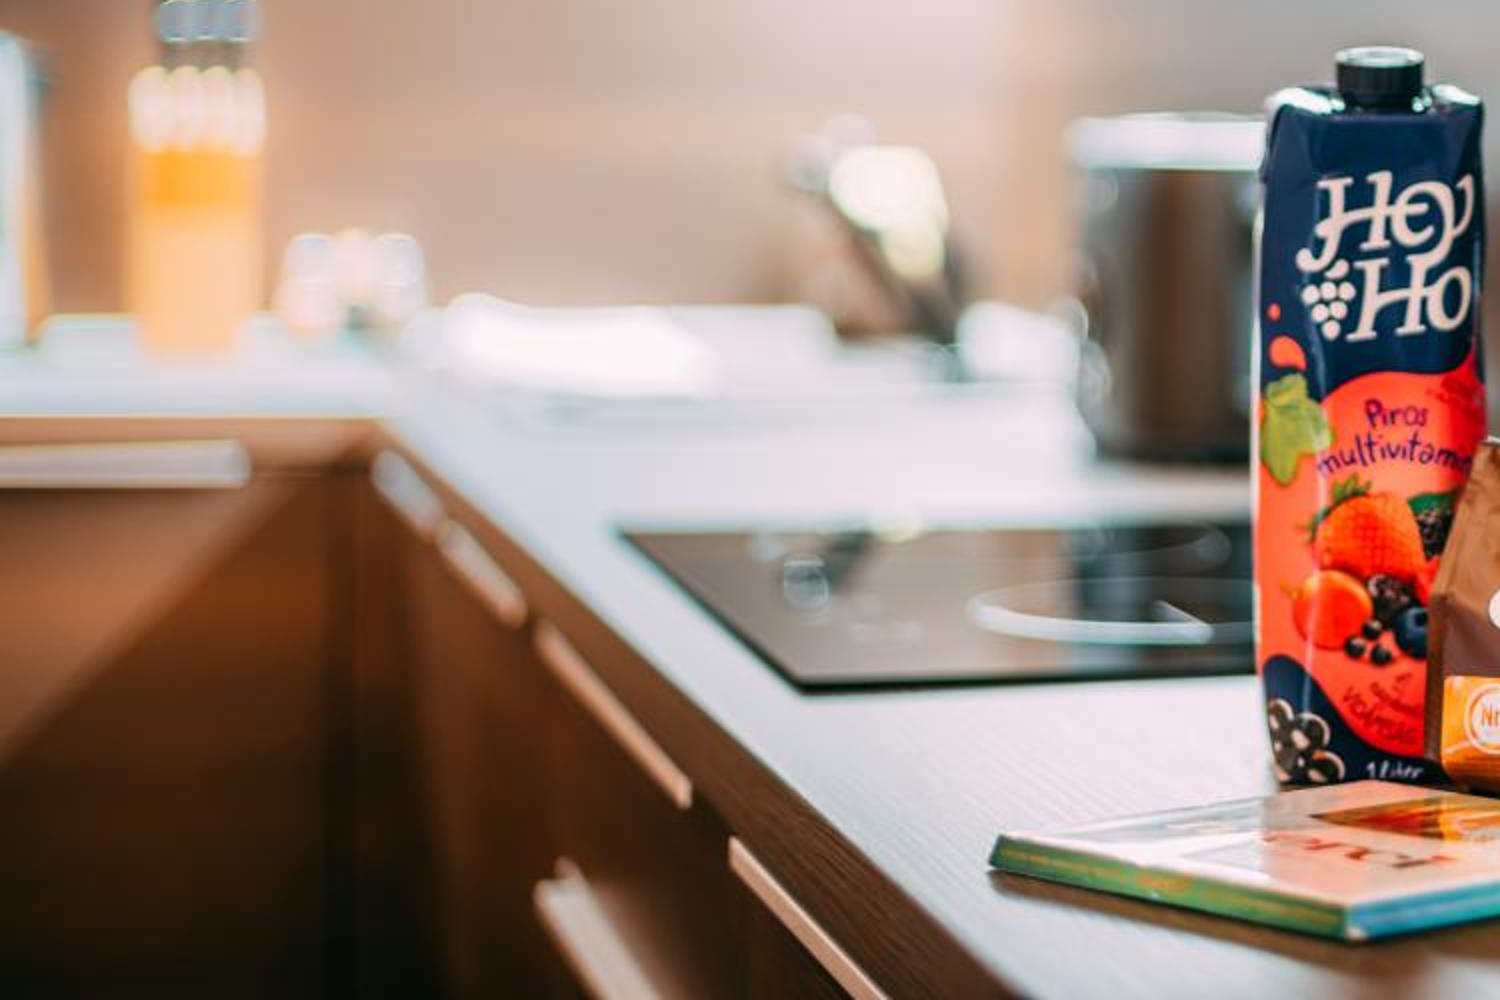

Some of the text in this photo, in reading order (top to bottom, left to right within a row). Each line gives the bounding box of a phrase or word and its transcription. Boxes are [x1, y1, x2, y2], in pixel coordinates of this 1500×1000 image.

[1295, 170, 1475, 273] Hey
[1346, 256, 1472, 341] Ho
[1365, 399, 1428, 428] Piros
